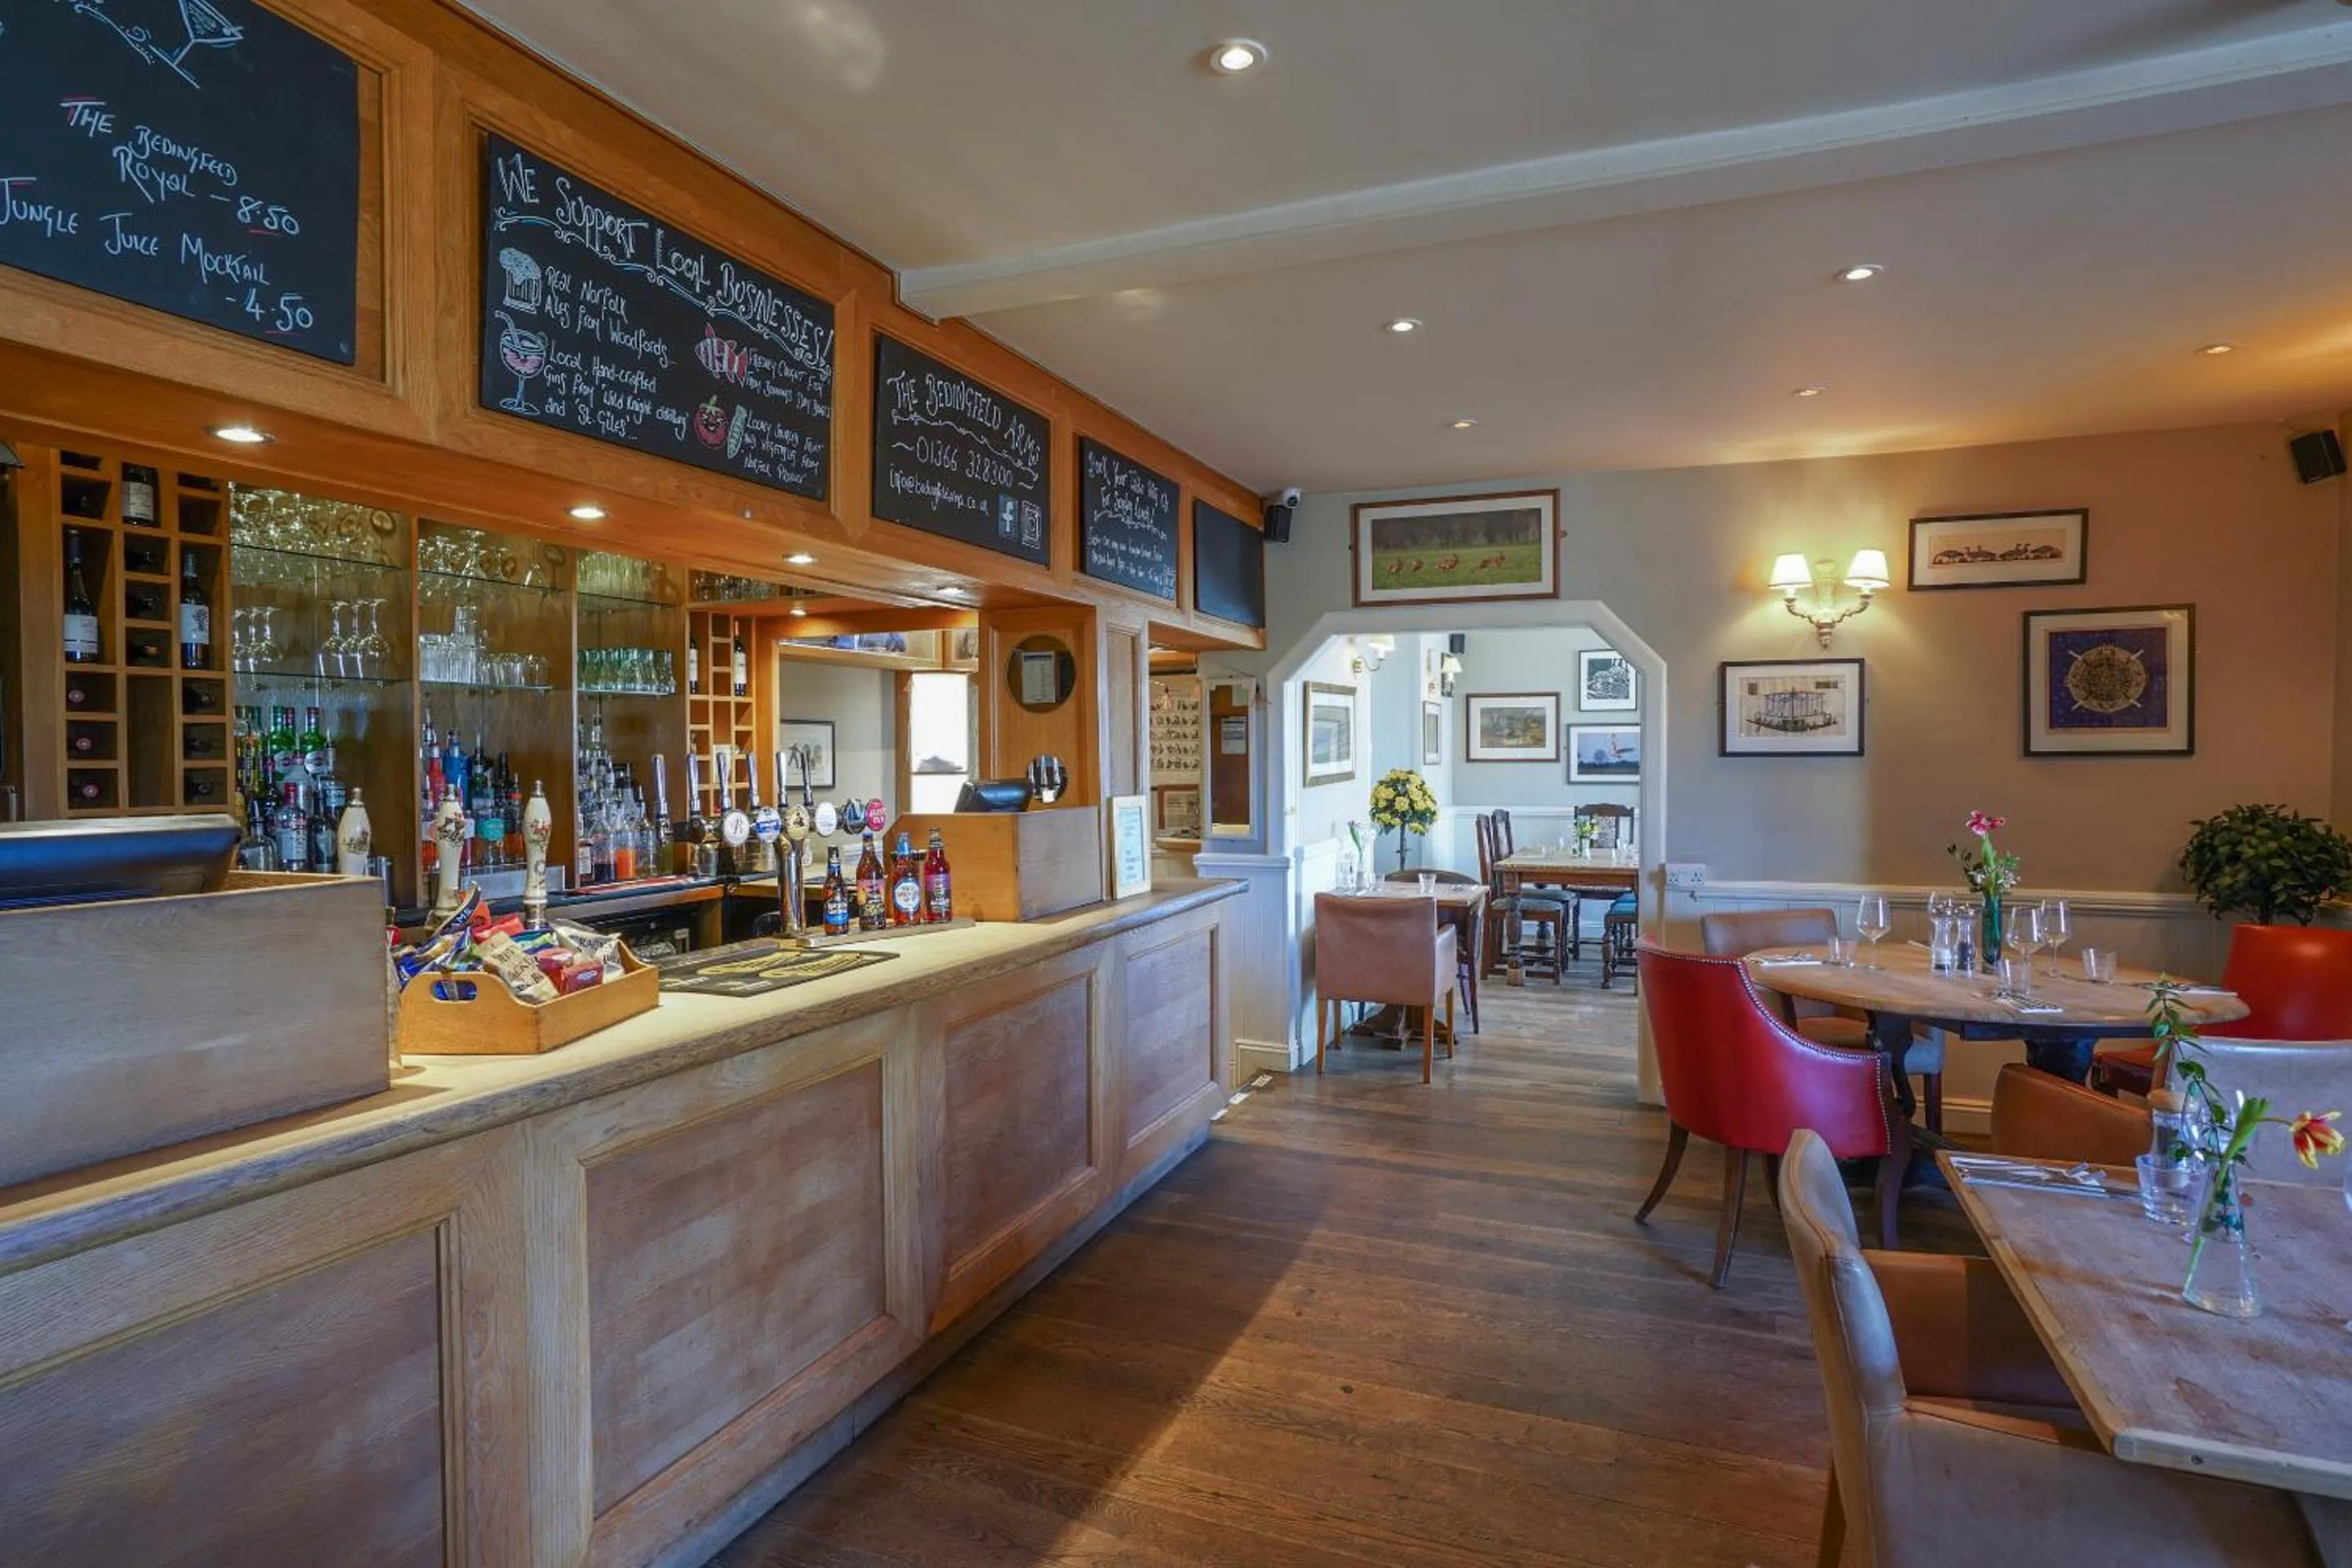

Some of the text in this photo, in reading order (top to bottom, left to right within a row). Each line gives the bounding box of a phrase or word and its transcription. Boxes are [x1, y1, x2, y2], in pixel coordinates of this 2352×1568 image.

[60, 101, 115, 137] THE
[113, 146, 196, 203] ROYAL
[0, 177, 270, 284] JUNGLE JUICE MOCKTAIL
[497, 153, 540, 204] WE
[556, 176, 649, 259] SUPPORT
[656, 227, 711, 291] LOCAL
[887, 370, 918, 411] THE
[1004, 414, 1041, 467] ARMS
[917, 437, 1013, 487] 01366 328300
